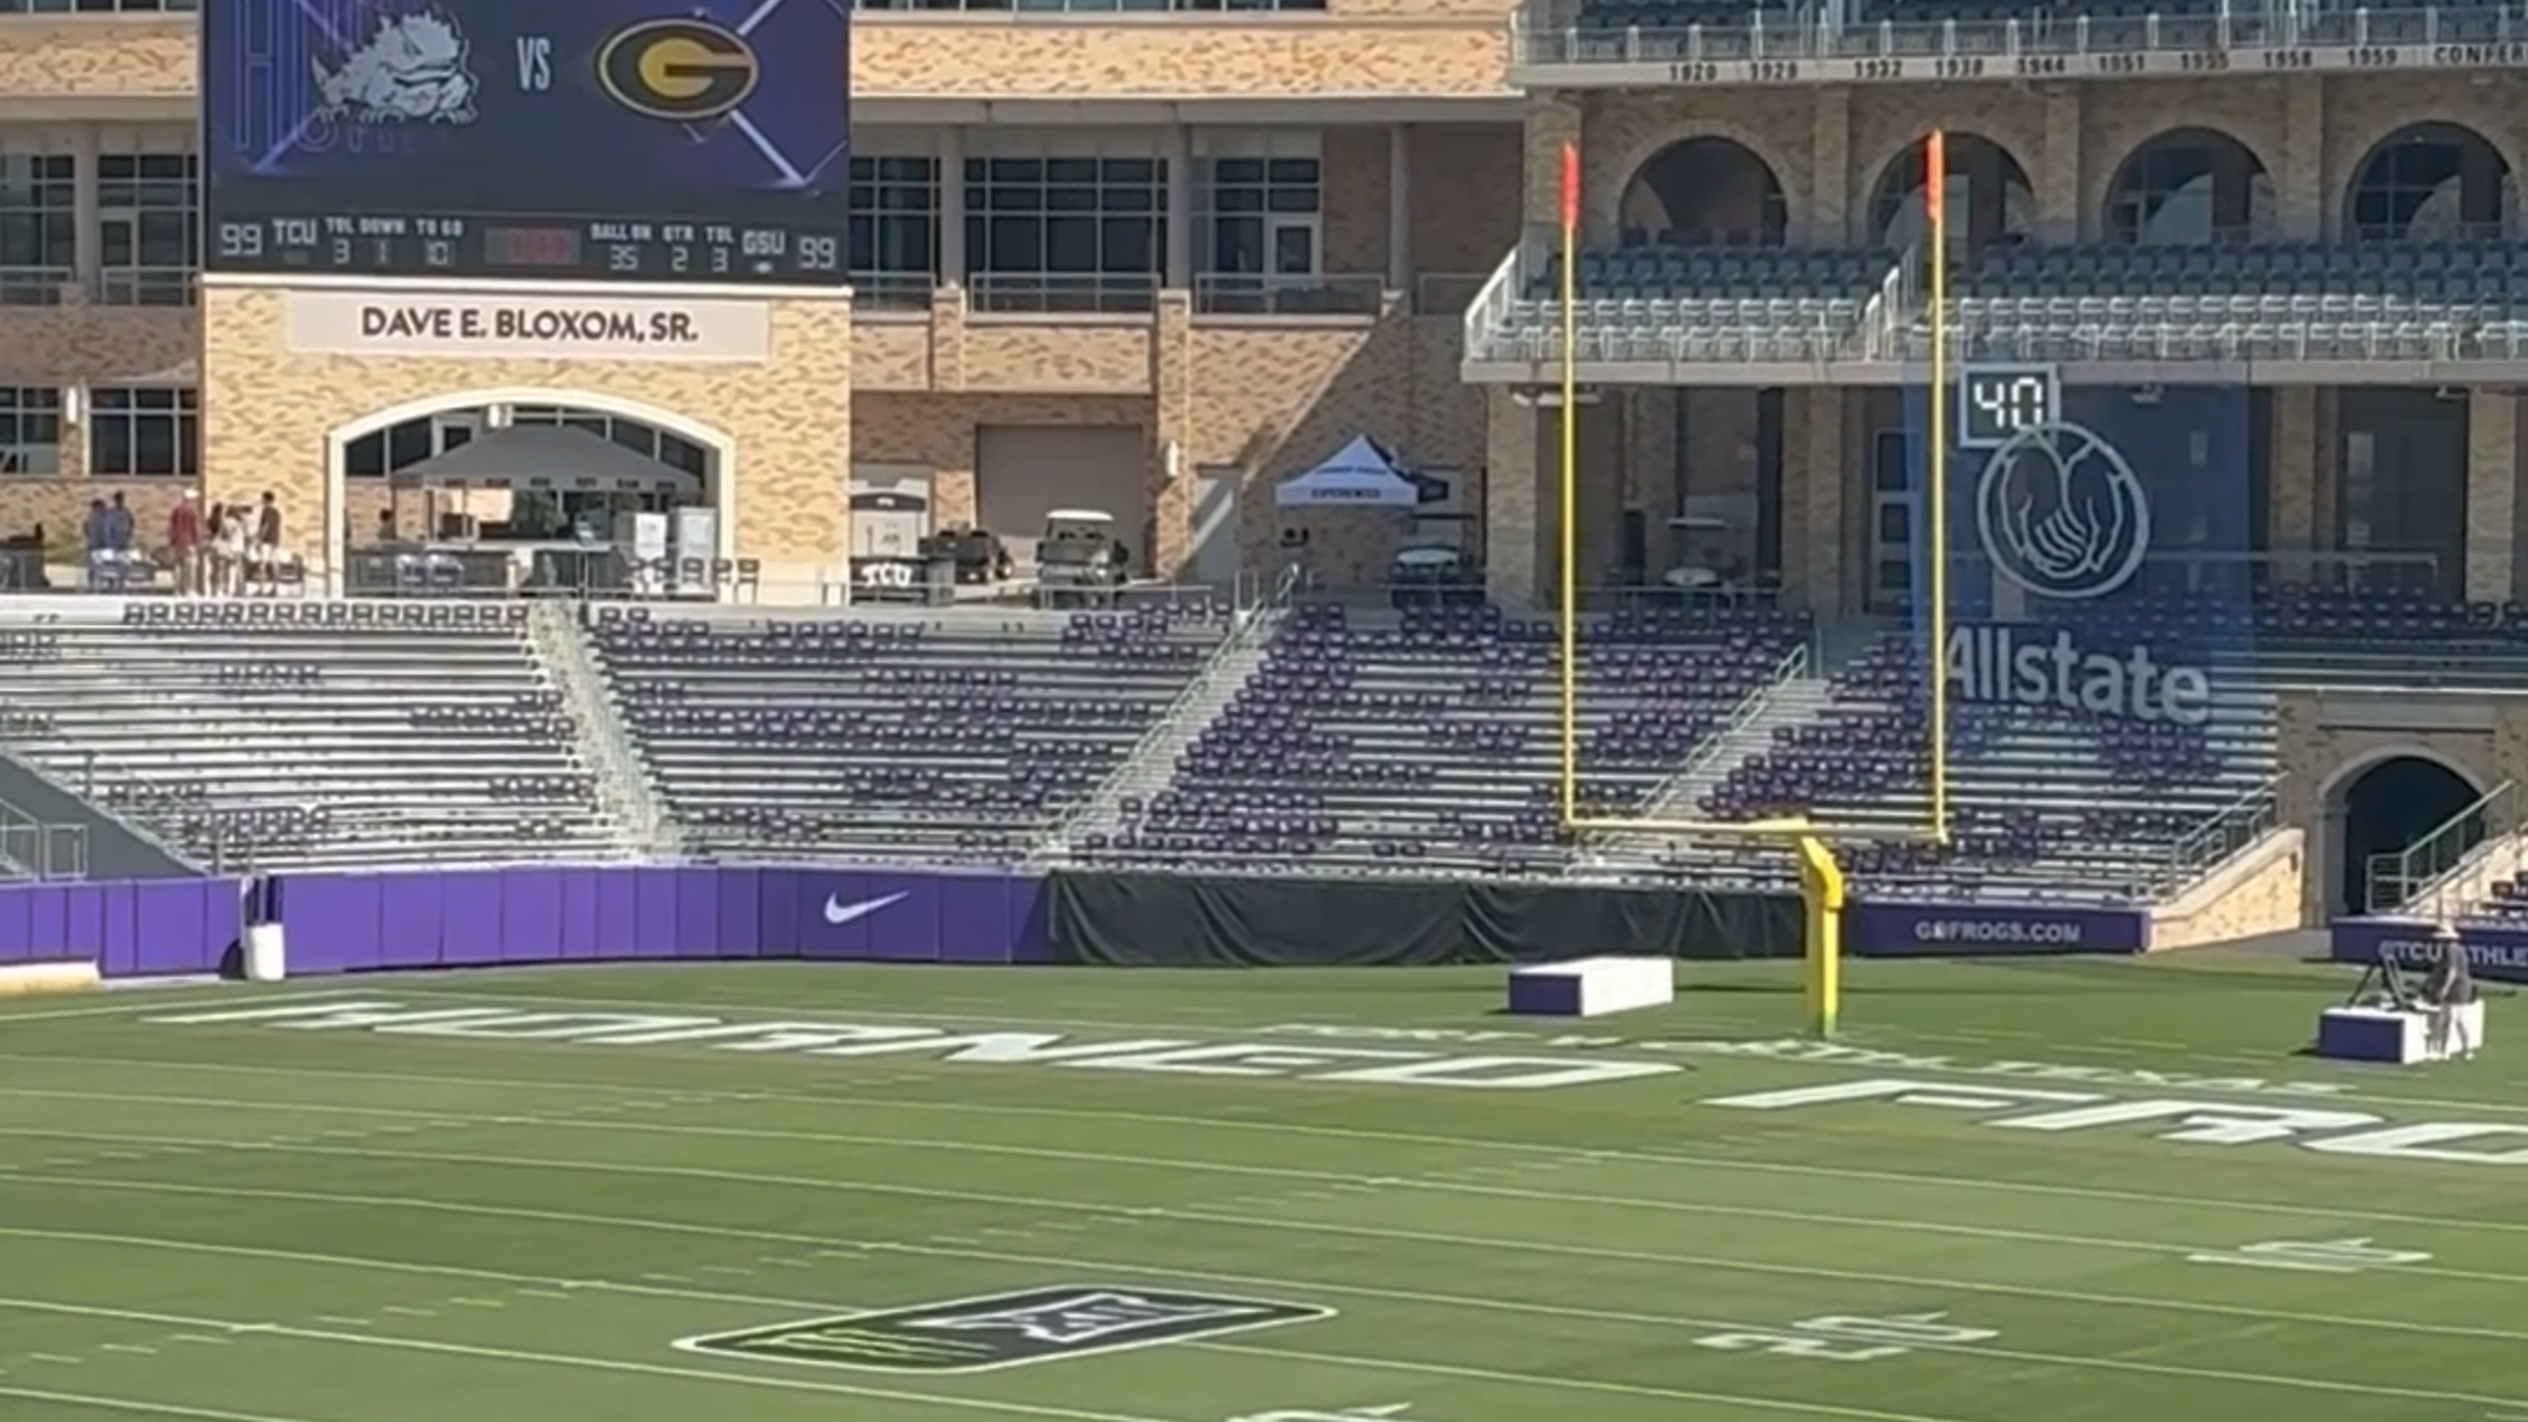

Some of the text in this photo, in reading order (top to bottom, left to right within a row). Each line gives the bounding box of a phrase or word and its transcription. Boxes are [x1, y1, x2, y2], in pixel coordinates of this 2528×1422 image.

[517, 37, 550, 90] VS
[220, 224, 262, 256] 99
[272, 218, 317, 244] TCU
[742, 230, 786, 255] GSU
[334, 238, 350, 264] 3
[671, 246, 688, 272] 2
[711, 247, 728, 273] 3
[800, 236, 836, 269] 99
[362, 307, 699, 343] DAVE E. BLOXOM, SR.
[1973, 377, 2042, 431] 40
[1946, 627, 2209, 724] Allstate
[140, 1001, 1686, 1088] HORNED
[1692, 1315, 2000, 1361] 20
